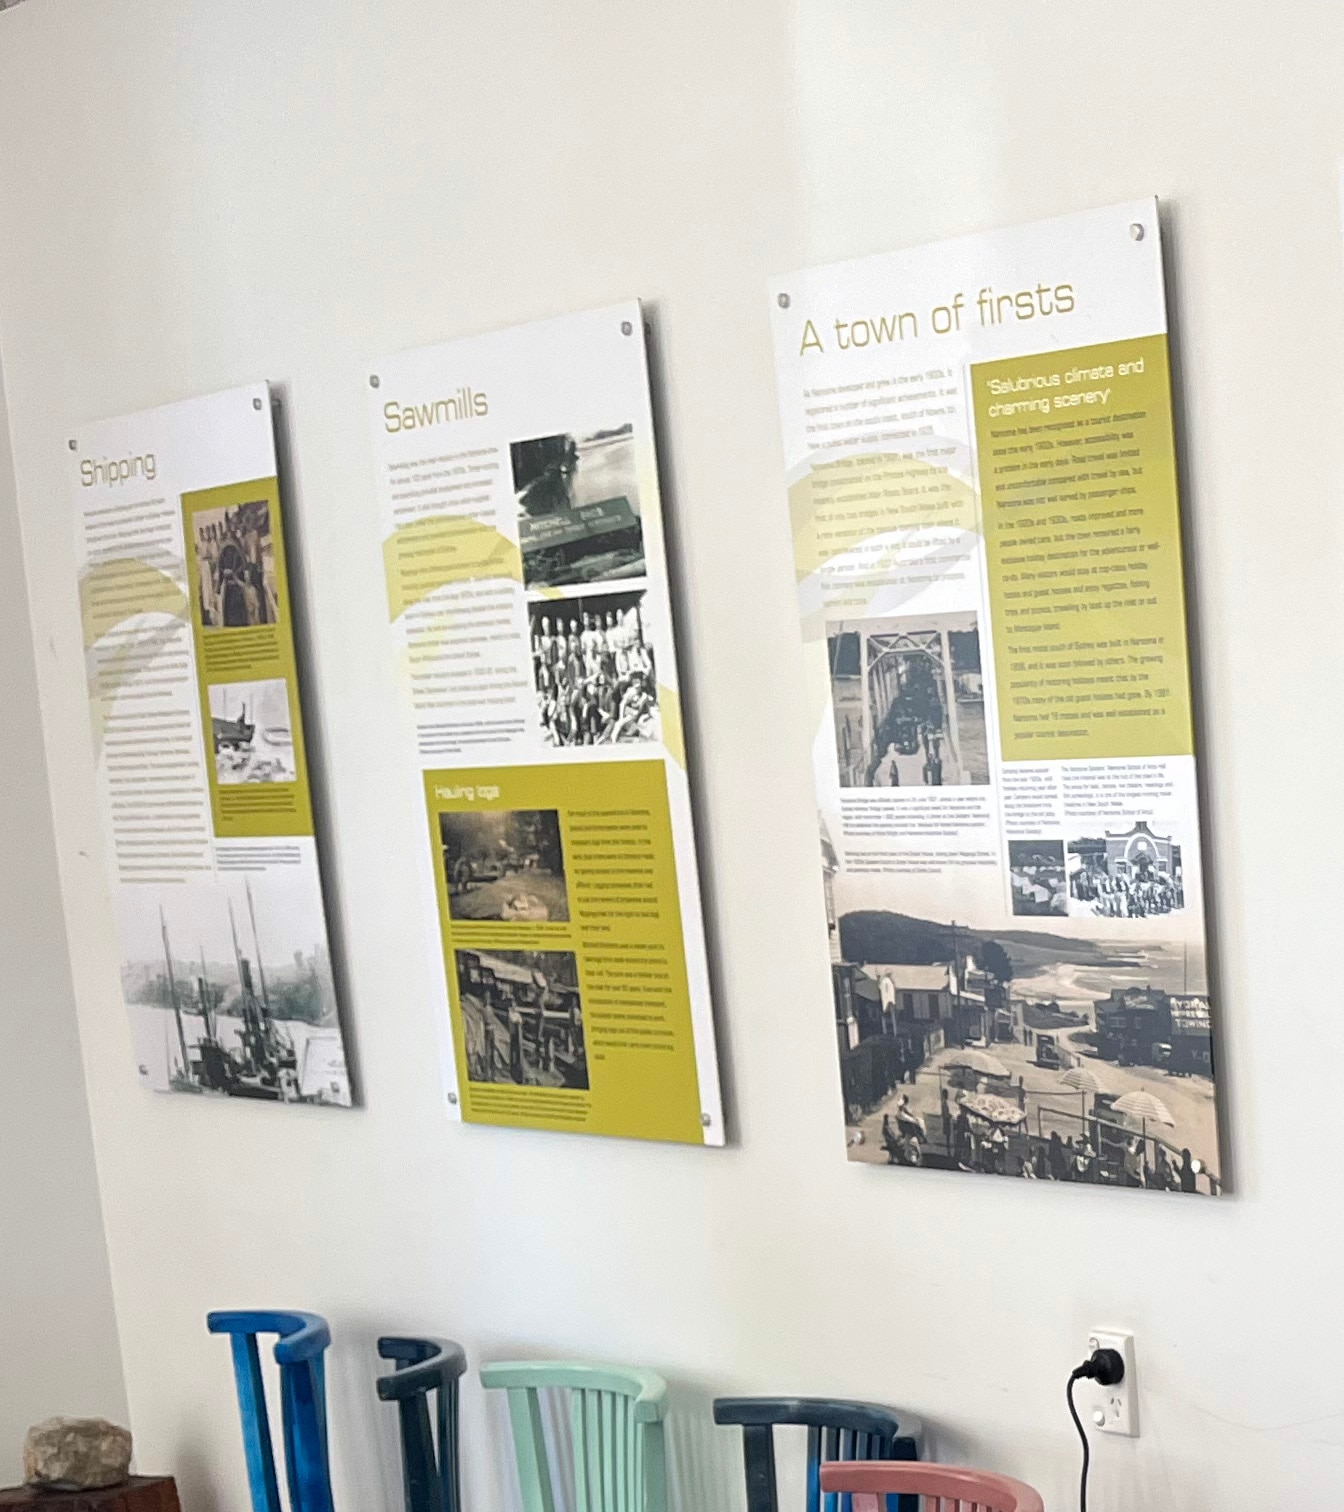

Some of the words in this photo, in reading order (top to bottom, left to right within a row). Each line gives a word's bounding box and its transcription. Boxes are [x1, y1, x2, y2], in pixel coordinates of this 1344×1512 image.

[800, 319, 824, 356] A
[835, 311, 918, 350] town
[932, 293, 964, 335] of
[977, 283, 1076, 327] firsts
[1065, 365, 1113, 386] climate
[1118, 358, 1144, 378] and
[383, 387, 489, 433] Sawmills
[988, 397, 1050, 418] charming
[80, 451, 156, 487] Shipping
